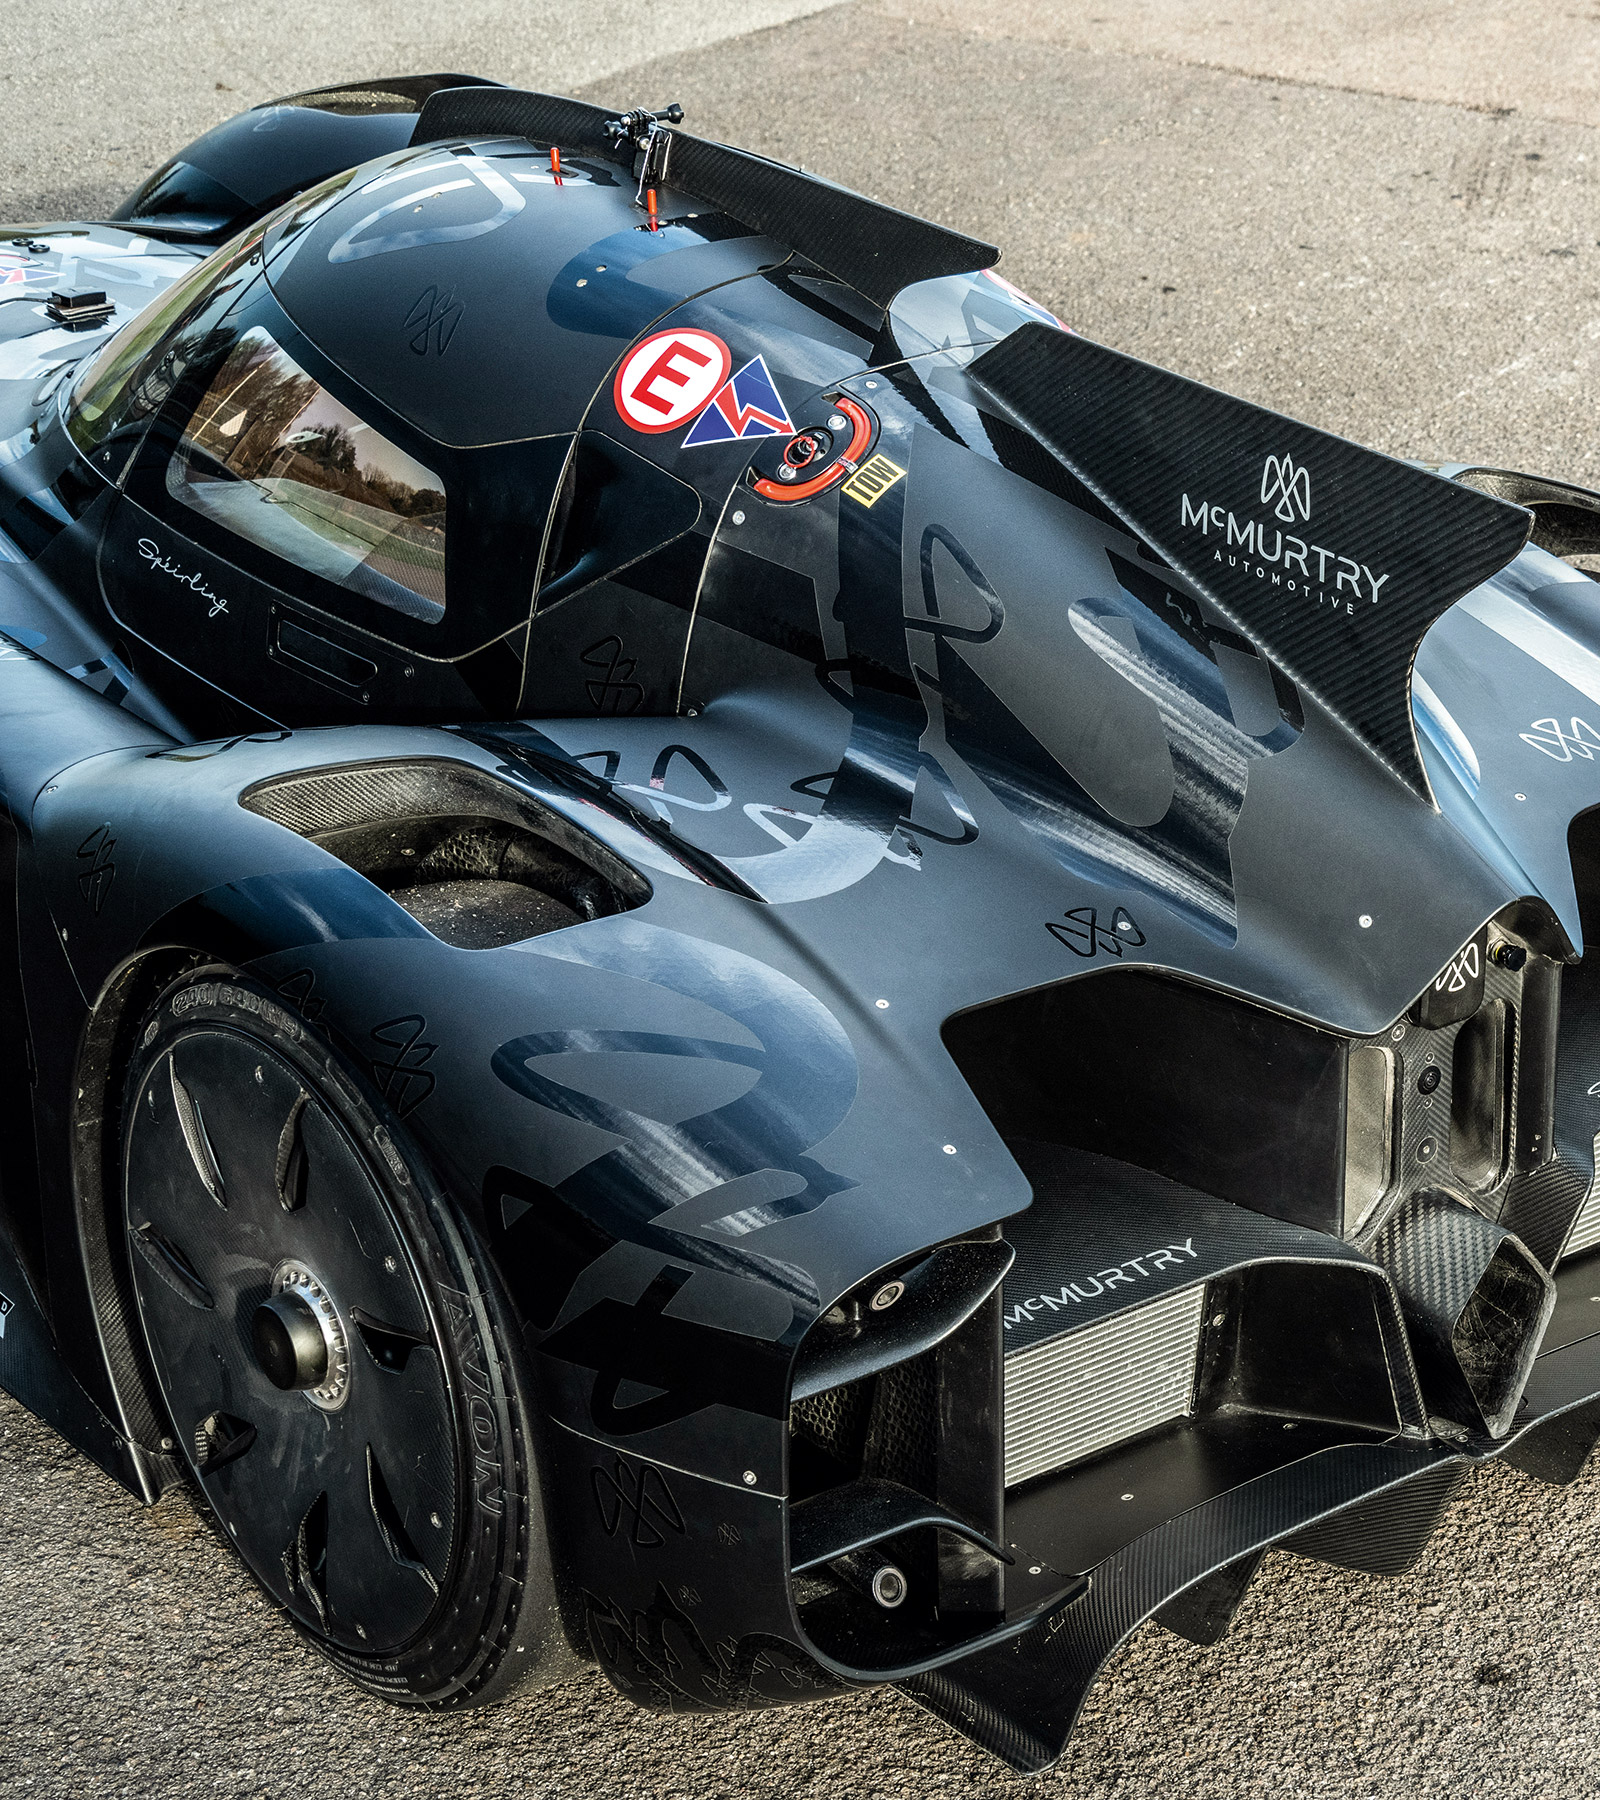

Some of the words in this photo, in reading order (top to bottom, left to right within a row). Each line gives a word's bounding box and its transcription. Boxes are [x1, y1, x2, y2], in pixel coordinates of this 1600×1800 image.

[630, 340, 712, 416] E
[846, 457, 899, 502] TOW
[138, 538, 229, 617] Spéirling
[1181, 493, 1390, 604] McMURTRY
[1213, 550, 1354, 615] AUTOMOTIVE
[436, 1281, 504, 1516] AVON
